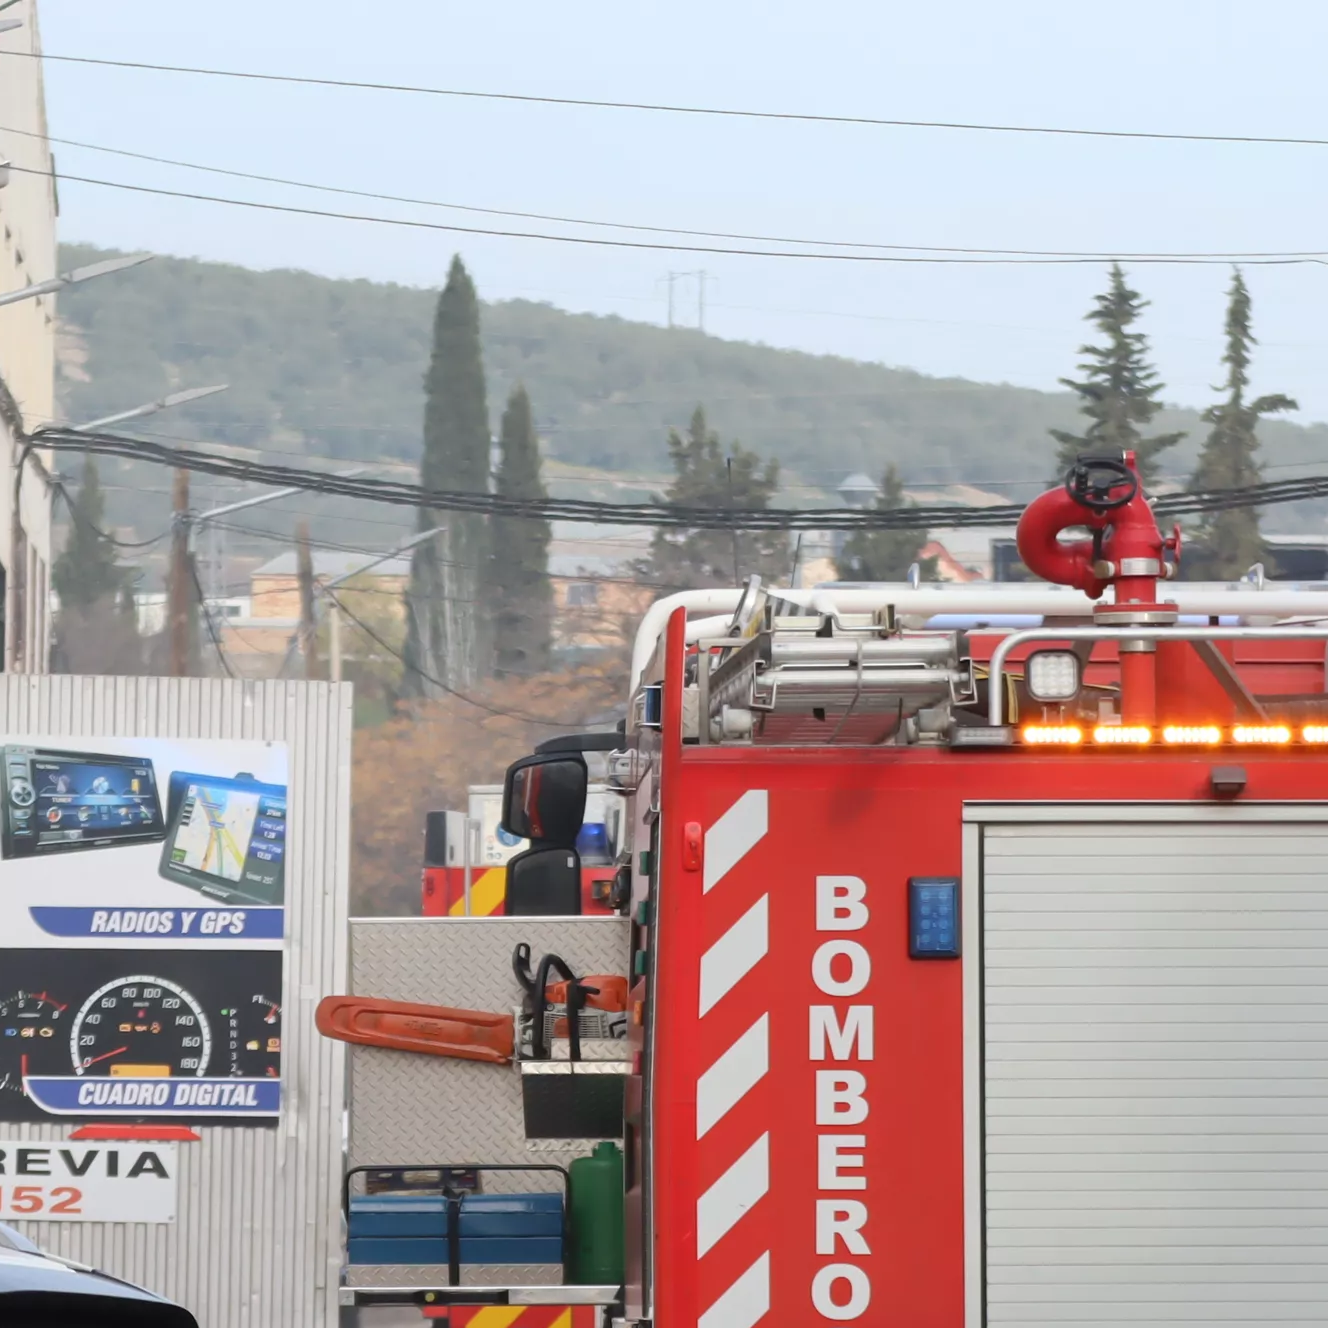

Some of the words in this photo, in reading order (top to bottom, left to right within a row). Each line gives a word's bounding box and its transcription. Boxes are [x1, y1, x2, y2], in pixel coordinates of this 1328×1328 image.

[91, 911, 174, 934] RADIOS
[180, 911, 199, 934] Y
[200, 911, 246, 934] GPS
[122, 988, 137, 998] 80
[143, 988, 162, 999] 100
[101, 998, 117, 1008] 60
[162, 998, 181, 1009] 120
[85, 1014, 101, 1025] 40
[175, 1015, 194, 1026] 140
[79, 1035, 95, 1046] 20
[182, 1036, 201, 1047] 160
[180, 1058, 199, 1069] 180
[78, 1082, 170, 1106] CUADRO
[173, 1083, 259, 1106] DIGITAL
